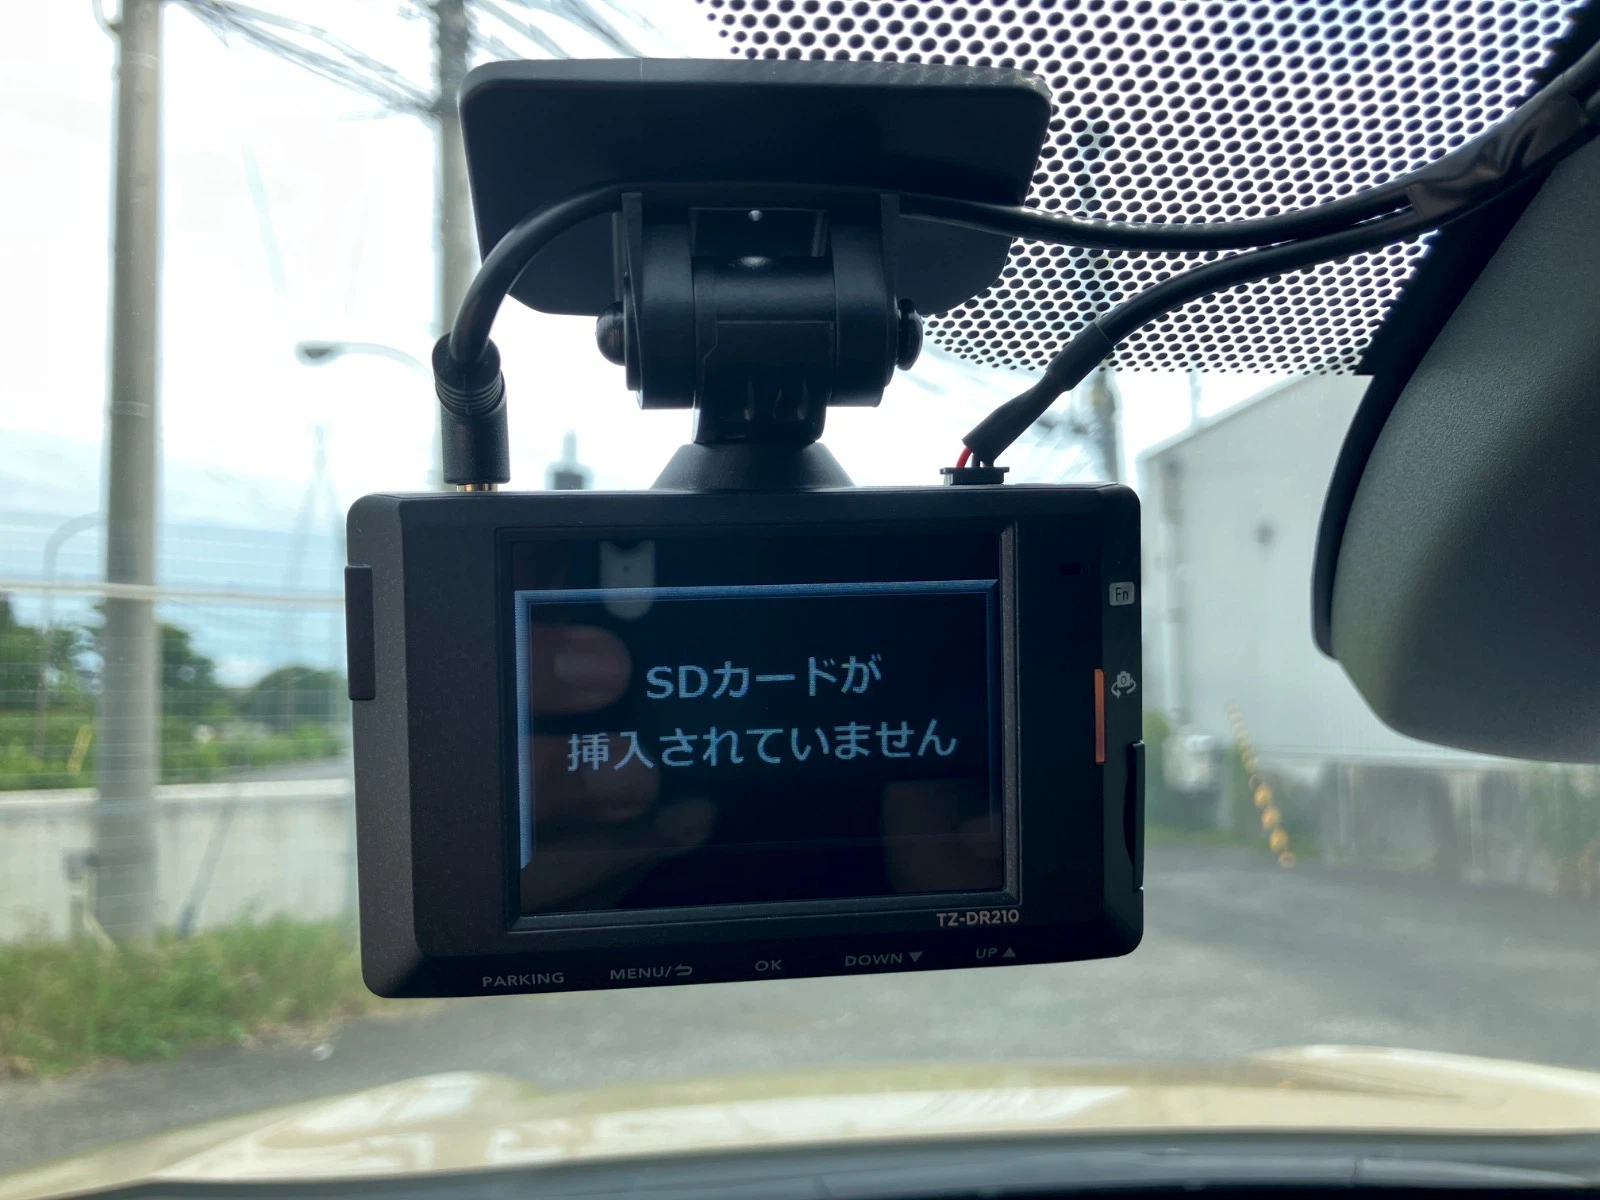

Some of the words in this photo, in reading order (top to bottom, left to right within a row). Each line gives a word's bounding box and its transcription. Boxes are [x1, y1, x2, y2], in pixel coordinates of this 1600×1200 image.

[646, 653, 882, 700] SDカードが
[566, 718, 958, 773] 挿入されていません
[936, 910, 1020, 927] TZ-DR210
[844, 953, 903, 967] DOWN
[975, 947, 998, 960] UP
[754, 959, 782, 972] OK
[482, 972, 565, 988] PARKING
